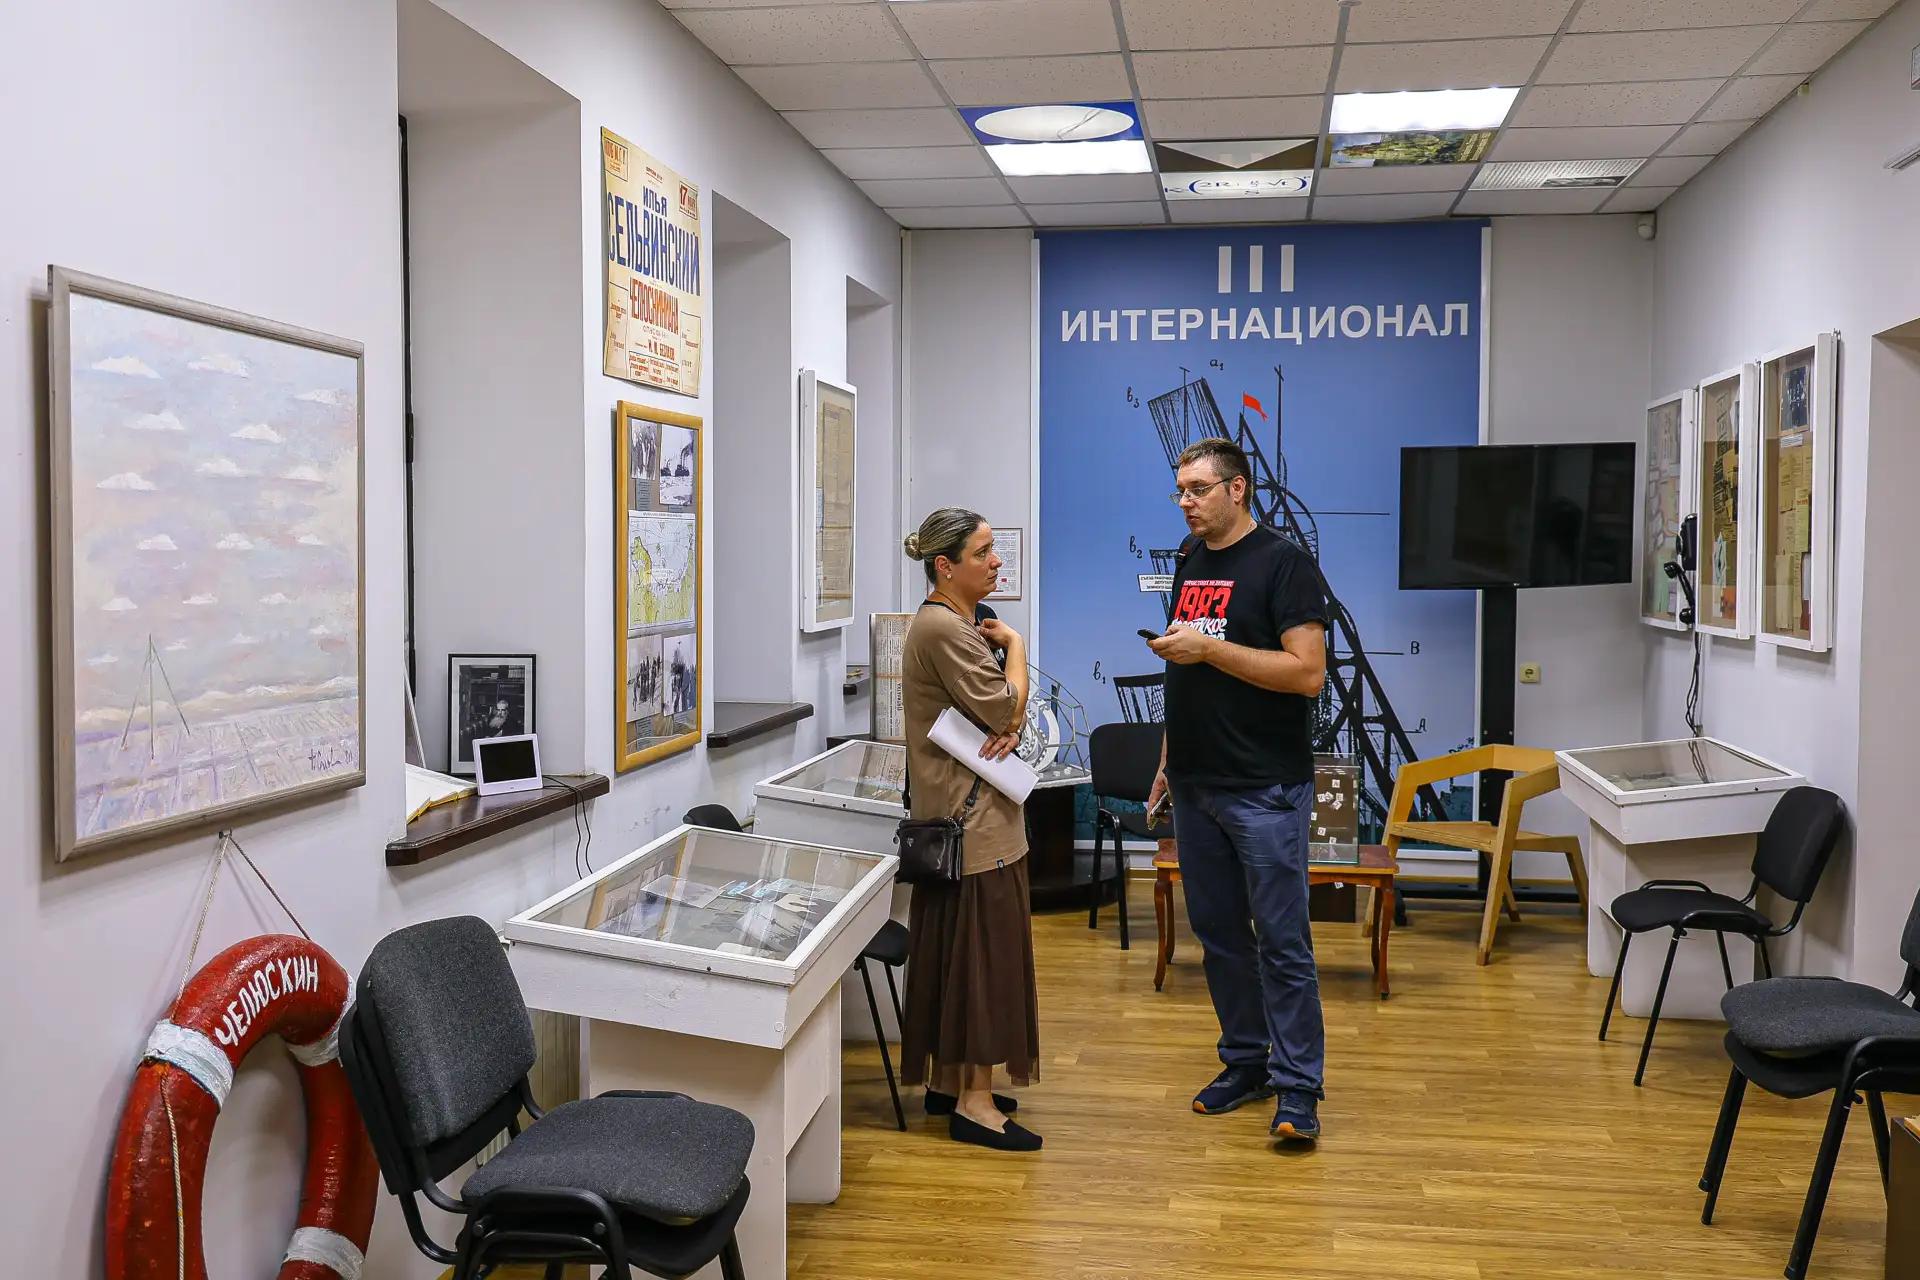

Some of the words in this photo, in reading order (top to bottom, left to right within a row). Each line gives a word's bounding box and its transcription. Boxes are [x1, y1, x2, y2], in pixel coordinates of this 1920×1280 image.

[643, 185, 668, 218] ИЛЬЯ
[608, 191, 700, 297] СЕЛЬВИНСКИЙ
[1218, 244, 1295, 294] III
[1061, 302, 1469, 345] ИНТЕРНАЦИОНАЛ
[1174, 586, 1232, 622] 1983
[214, 955, 319, 1047] ЧЕЛЮСКИН
